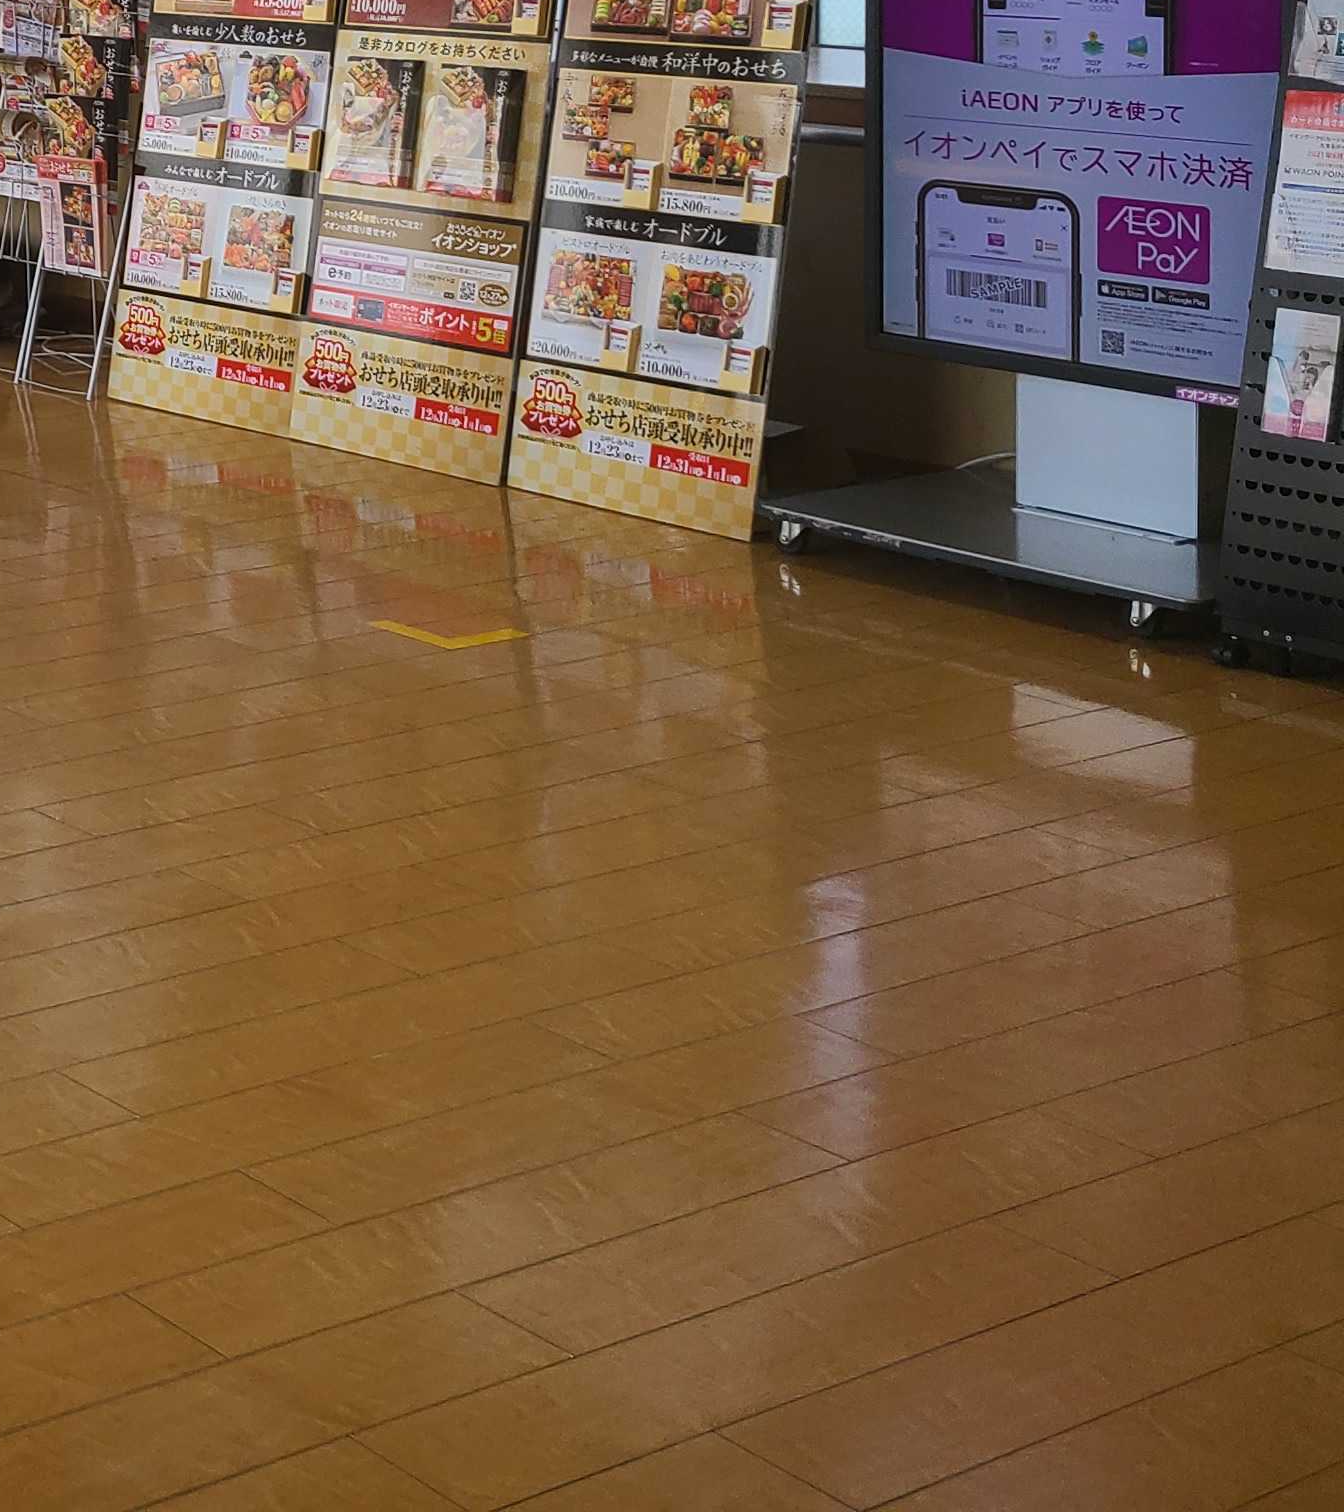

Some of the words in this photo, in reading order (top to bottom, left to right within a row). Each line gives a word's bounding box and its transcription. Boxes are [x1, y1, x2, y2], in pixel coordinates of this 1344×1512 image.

[214, 21, 308, 47] 少人数のおせち
[357, 37, 527, 61] 是非カタログをお持ちください
[661, 50, 788, 81] 和洋中のおせち
[961, 89, 1040, 115] iAEON
[1047, 93, 1185, 124] アプリを使って
[903, 130, 1255, 193] イオンペイでスマホ決済
[214, 165, 281, 189] オードブル
[642, 217, 729, 247] オードブル
[969, 276, 1025, 300] SAMPLE
[419, 307, 471, 331] ポイント
[124, 331, 162, 348] プレゼント
[308, 367, 353, 387] プレゼント
[1177, 388, 1240, 407] イオンチャン
[527, 410, 578, 431] プレゼント
